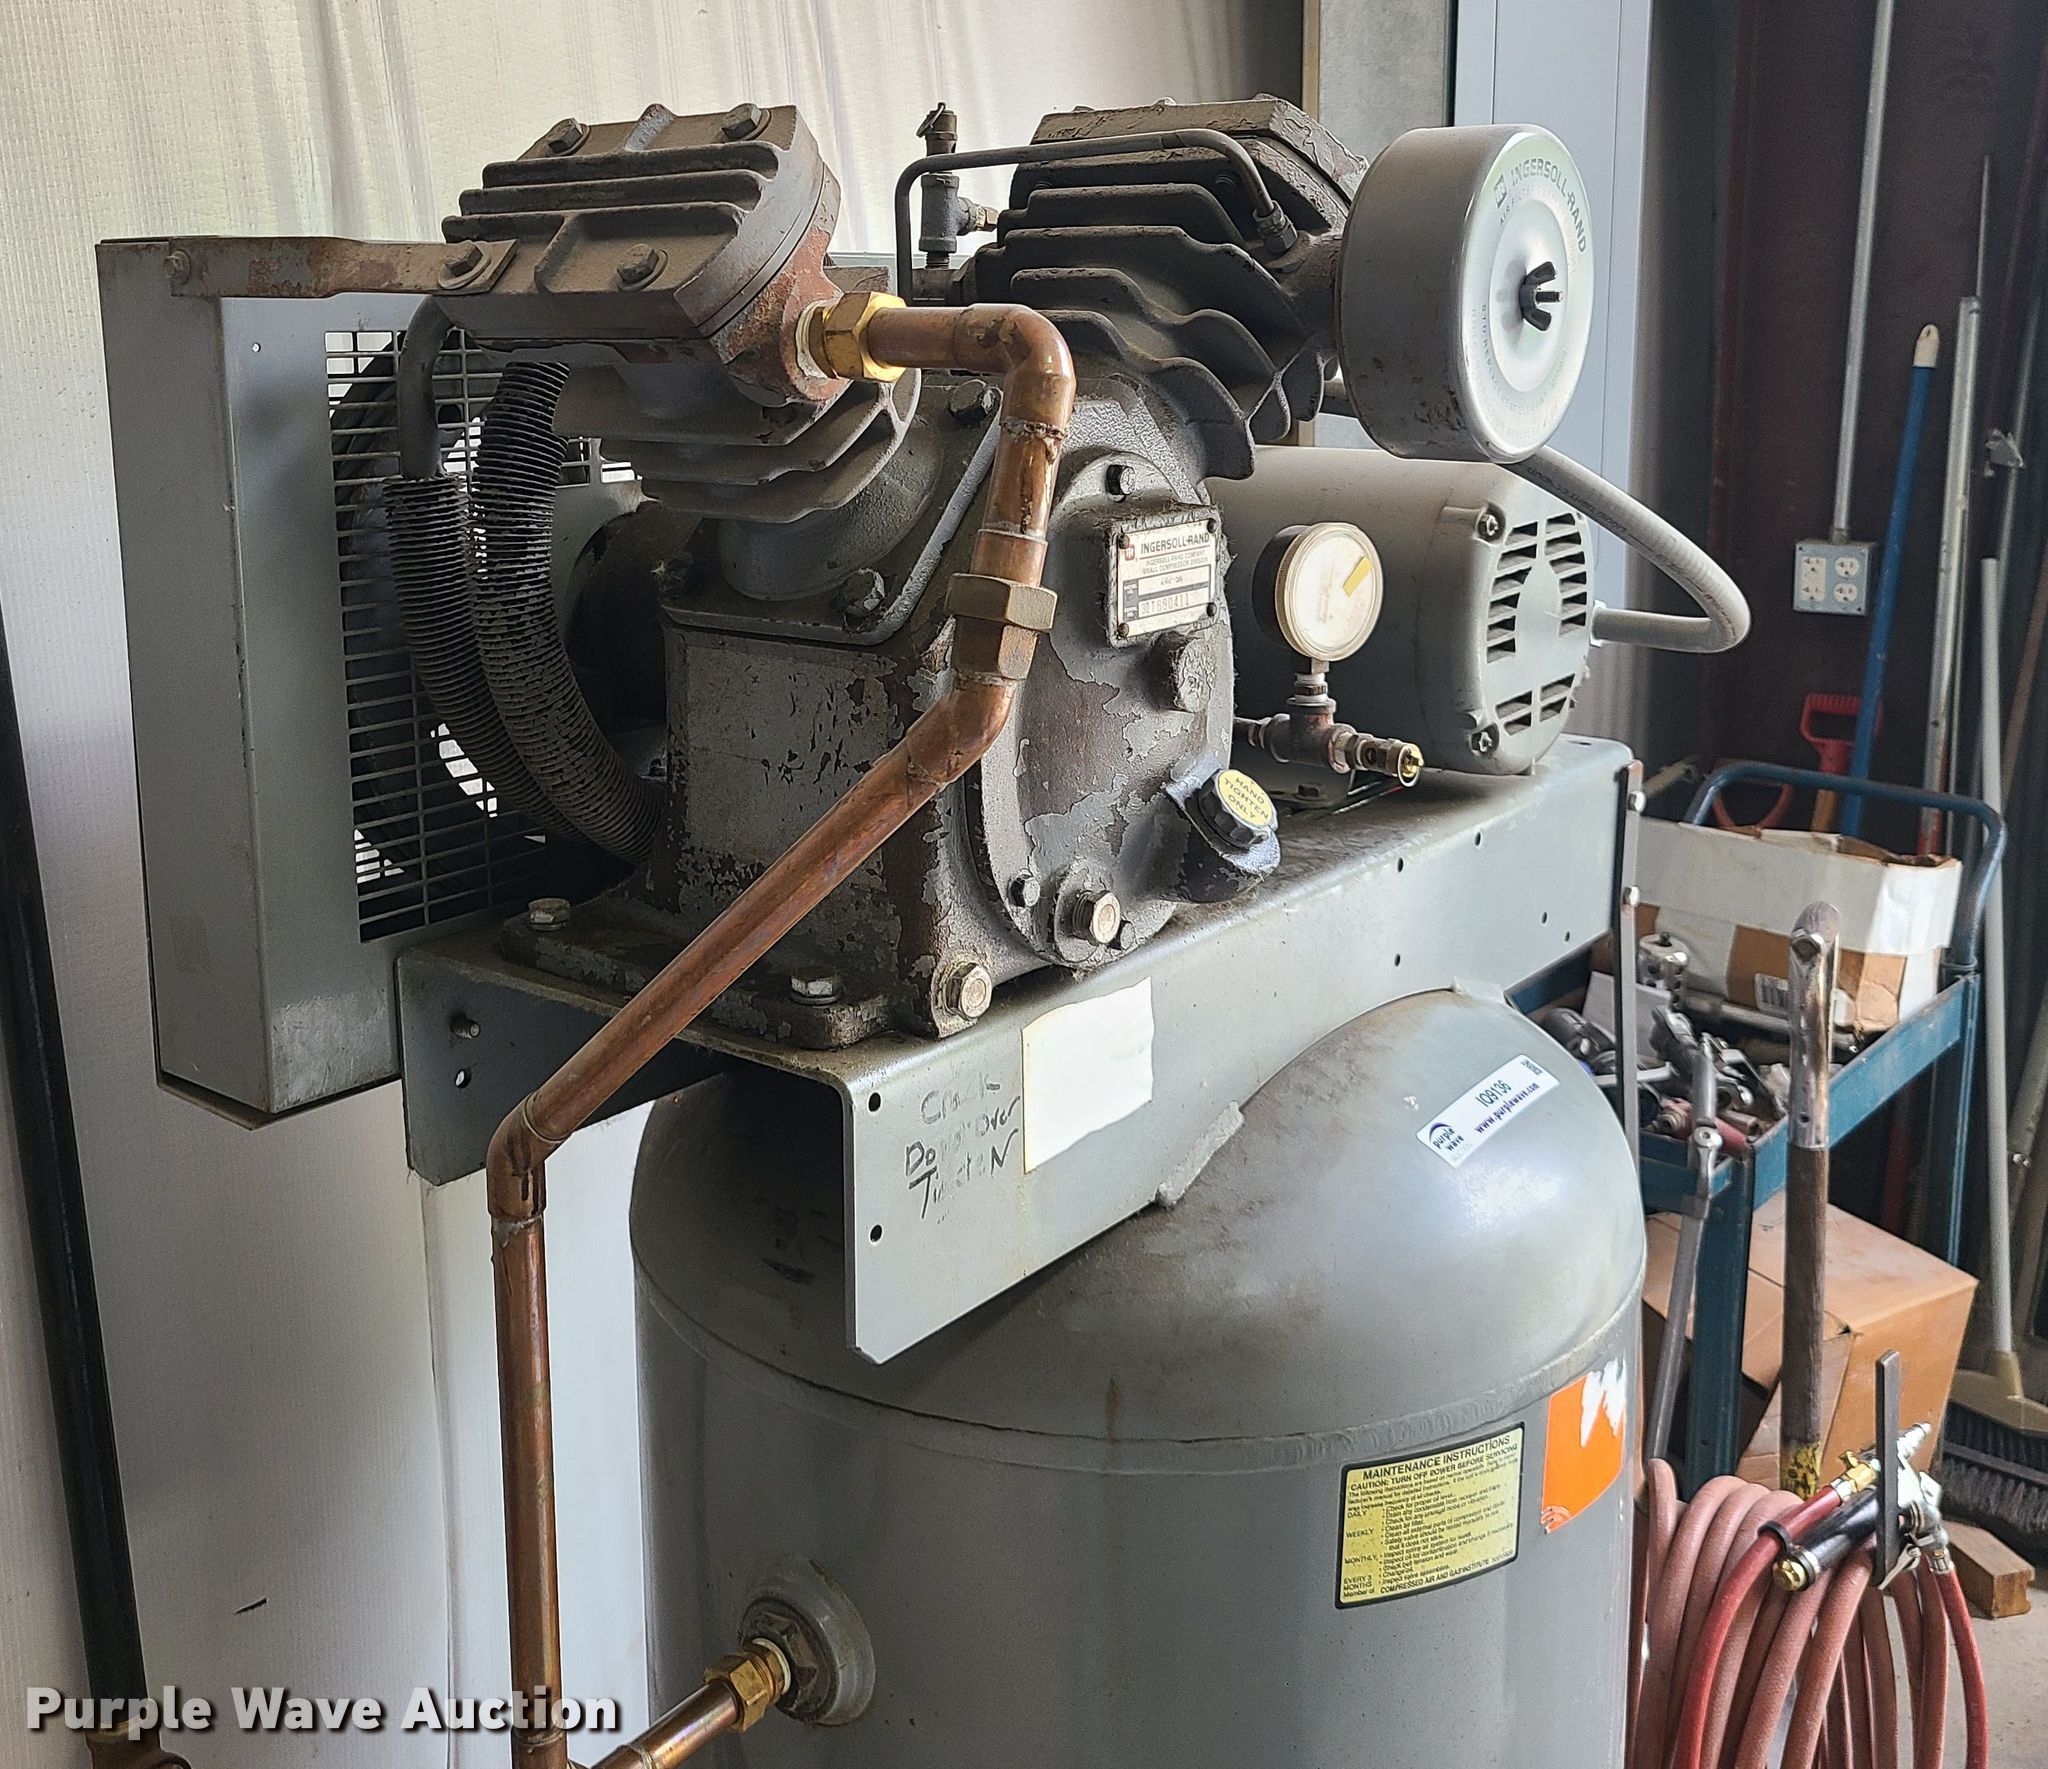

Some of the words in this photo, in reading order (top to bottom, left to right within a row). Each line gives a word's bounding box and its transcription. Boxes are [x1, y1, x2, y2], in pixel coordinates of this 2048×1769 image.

[1511, 158, 1586, 252] INGERSOLL-RAND
[1141, 533, 1210, 555] INGERSOLL-RAND
[1225, 777, 1269, 820] TIGHTEN
[1236, 777, 1265, 804] HAND
[1228, 794, 1256, 819] ONLY
[1474, 1082, 1540, 1134] www.purplewave.com
[1433, 1127, 1455, 1150] purple
[1446, 1135, 1465, 1151] wave
[1350, 1479, 1389, 1491] CAUTION:
[1391, 1474, 1411, 1485] TURN
[1413, 1471, 1427, 1480] OFF
[1429, 1464, 1456, 1477] POWER
[1457, 1455, 1484, 1470] BEFORE
[1485, 1443, 1518, 1461] SERVICING
[1363, 1456, 1441, 1480] MAINTENANCE
[1443, 1435, 1510, 1464] INSTRUCTIONS
[1348, 1510, 1367, 1518] DAILY
[1346, 1528, 1374, 1538] WEEKLY
[1344, 1554, 1377, 1564] MONTHLY
[1344, 1576, 1367, 1584] EVERY
[1344, 1589, 1367, 1597] Member
[1380, 1579, 1424, 1594] COMPRESSED
[1425, 1575, 1435, 1584] AIR
[1436, 1571, 1448, 1581] AND
[1449, 1567, 1461, 1577] GAS
[1344, 1581, 1372, 1590] MONTHS
